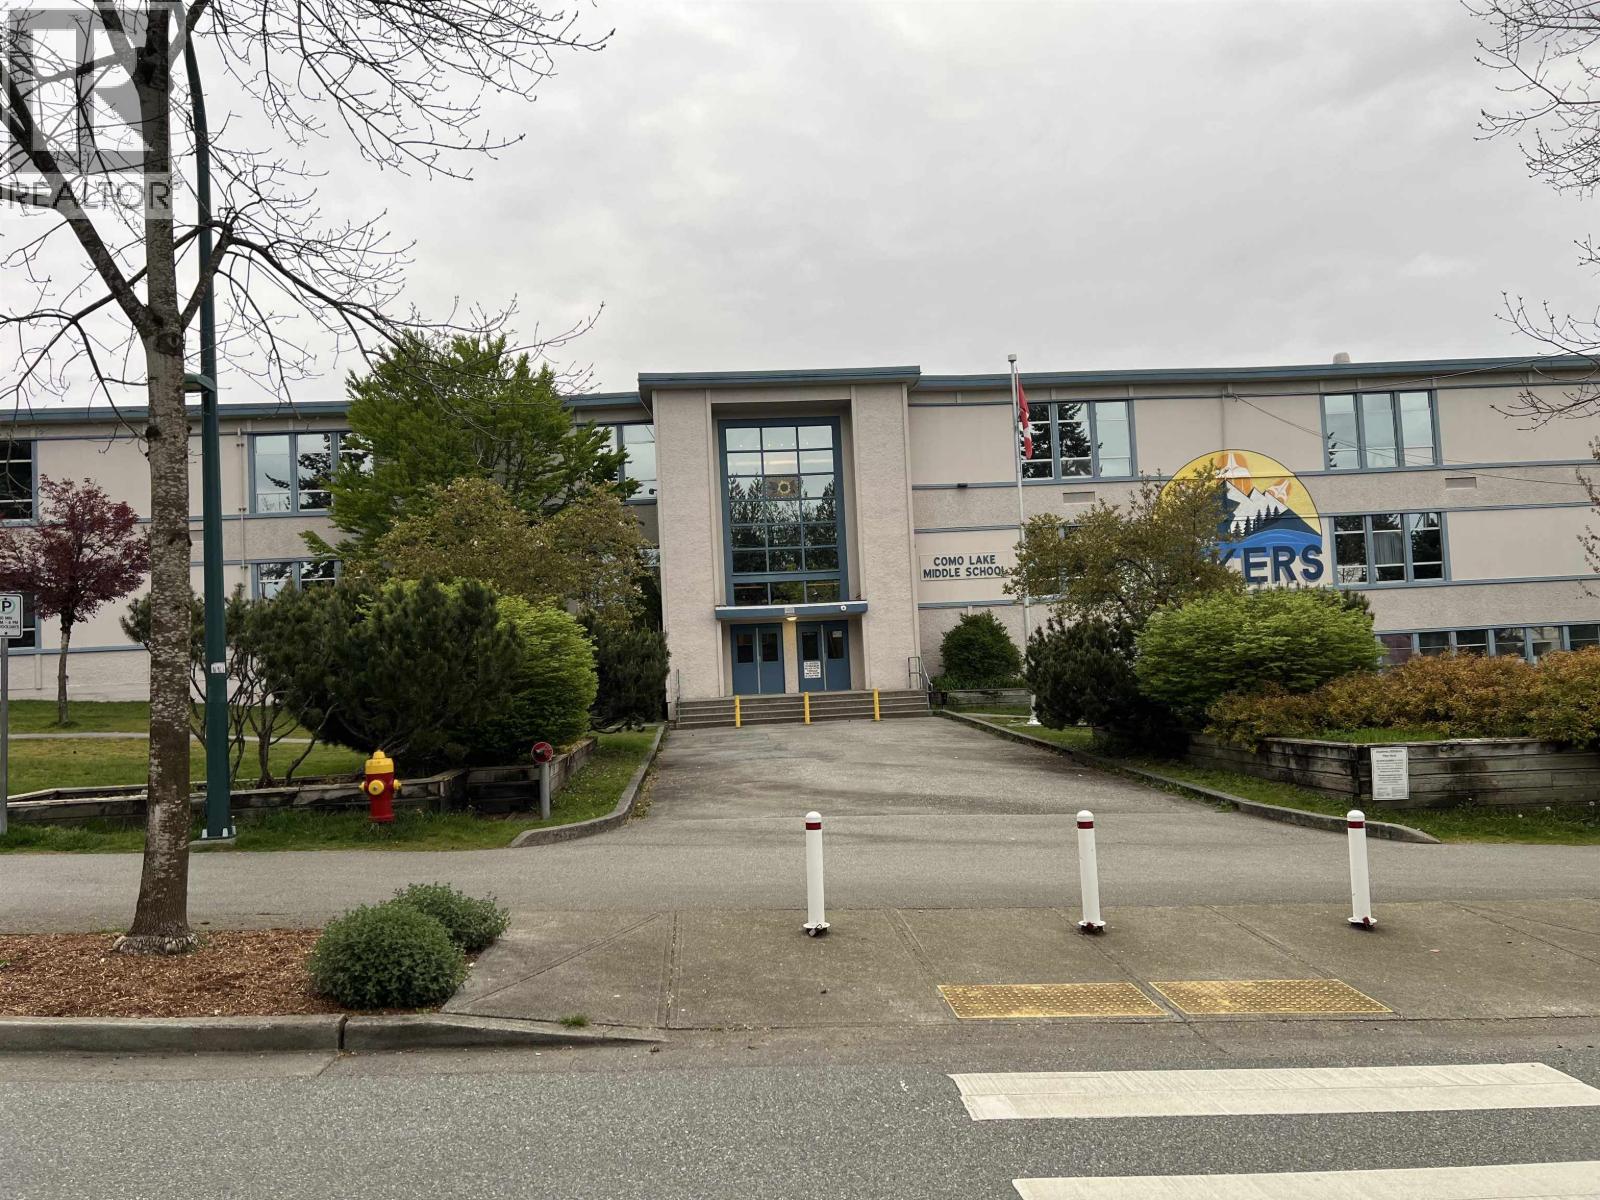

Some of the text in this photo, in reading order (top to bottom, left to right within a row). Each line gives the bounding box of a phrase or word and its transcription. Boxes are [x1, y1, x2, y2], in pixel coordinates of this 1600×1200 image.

[933, 554, 996, 567] COMO LAKE
[1219, 543, 1325, 583] ERS
[923, 566, 1006, 579] MIDDLE SCHOOL
[2, 600, 12, 612] P
